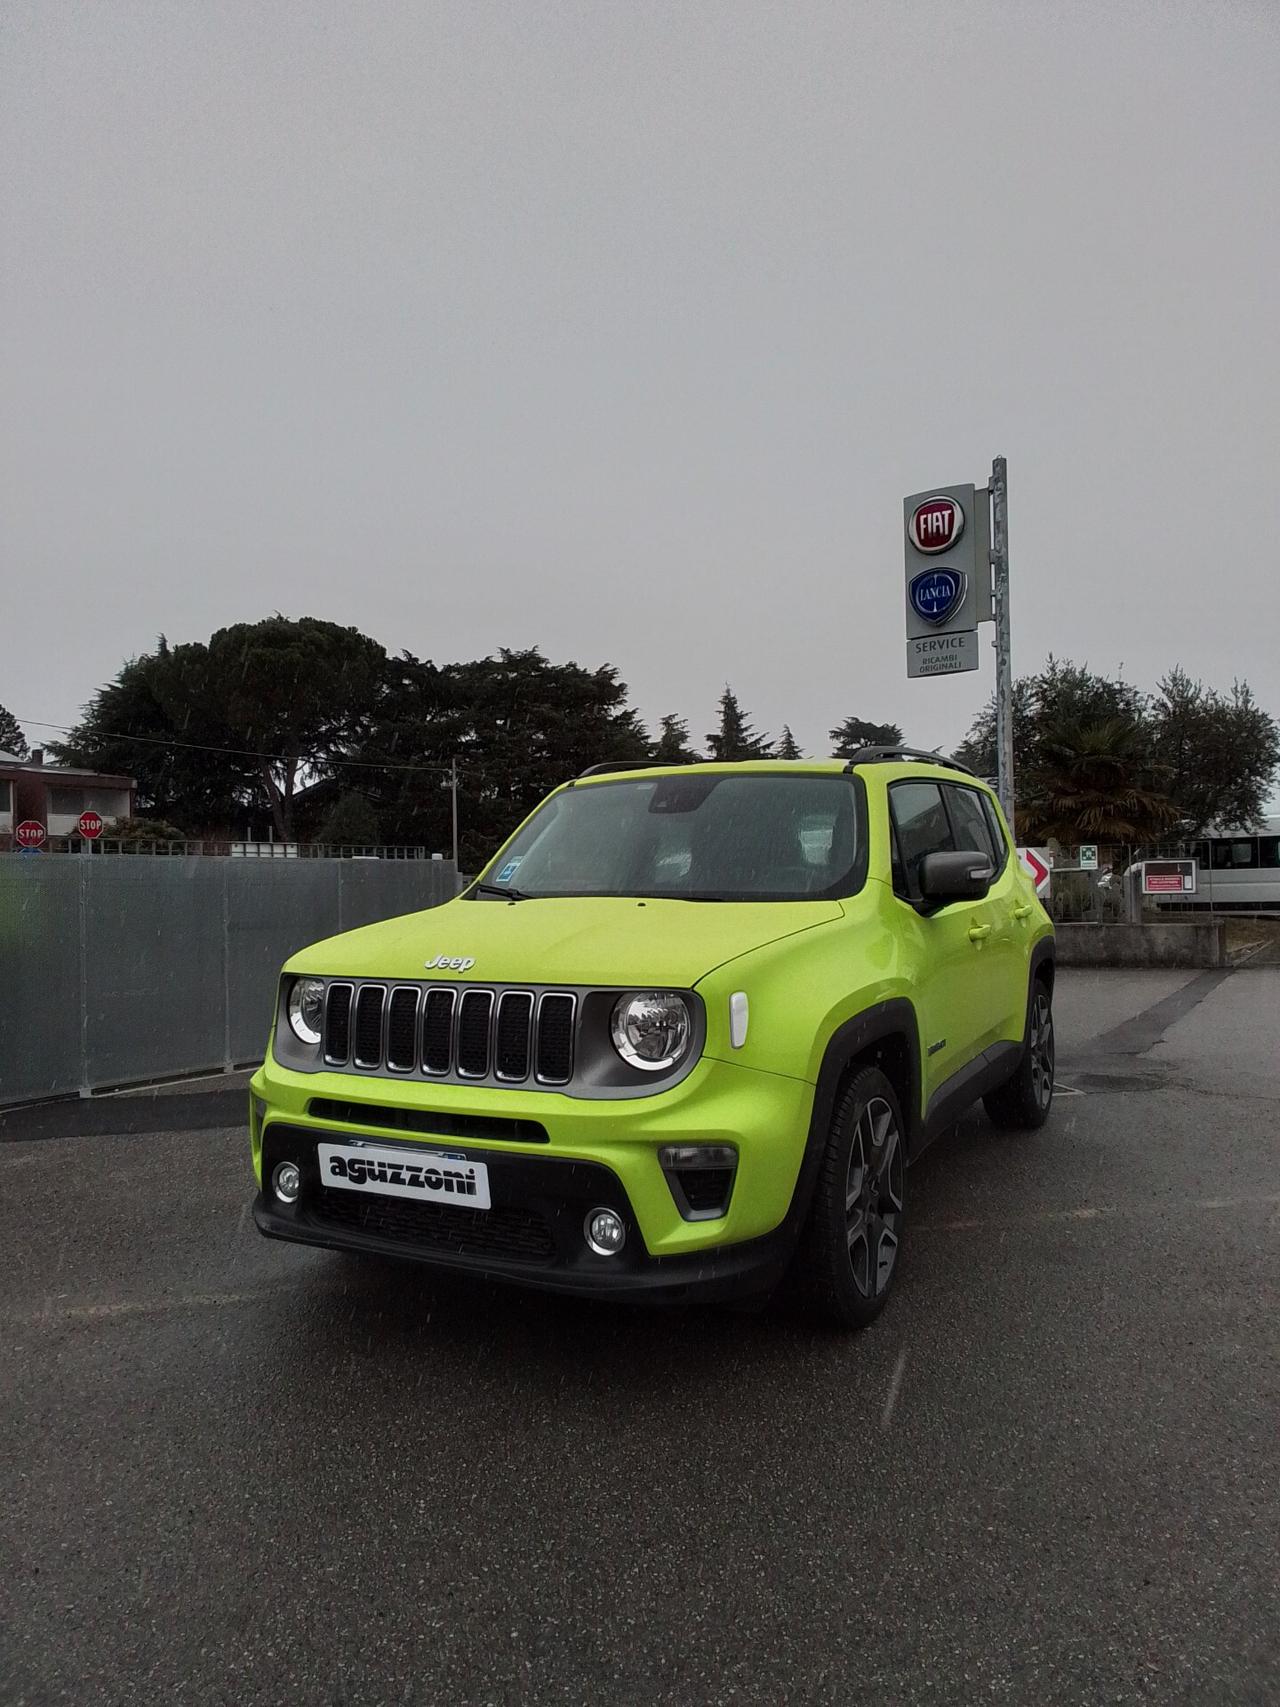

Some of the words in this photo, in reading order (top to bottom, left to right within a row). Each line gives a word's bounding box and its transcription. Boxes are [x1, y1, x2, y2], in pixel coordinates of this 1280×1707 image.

[920, 509, 952, 540] FIAT
[920, 585, 951, 601] LANCIA
[915, 637, 966, 654] SERVICE
[919, 661, 962, 673] ORIGINALI
[922, 654, 958, 665] RICAMBI
[80, 819, 101, 830] STOP
[19, 829, 43, 839] STOP
[424, 954, 476, 974] Jeep
[329, 1155, 478, 1196] aguzzoni
